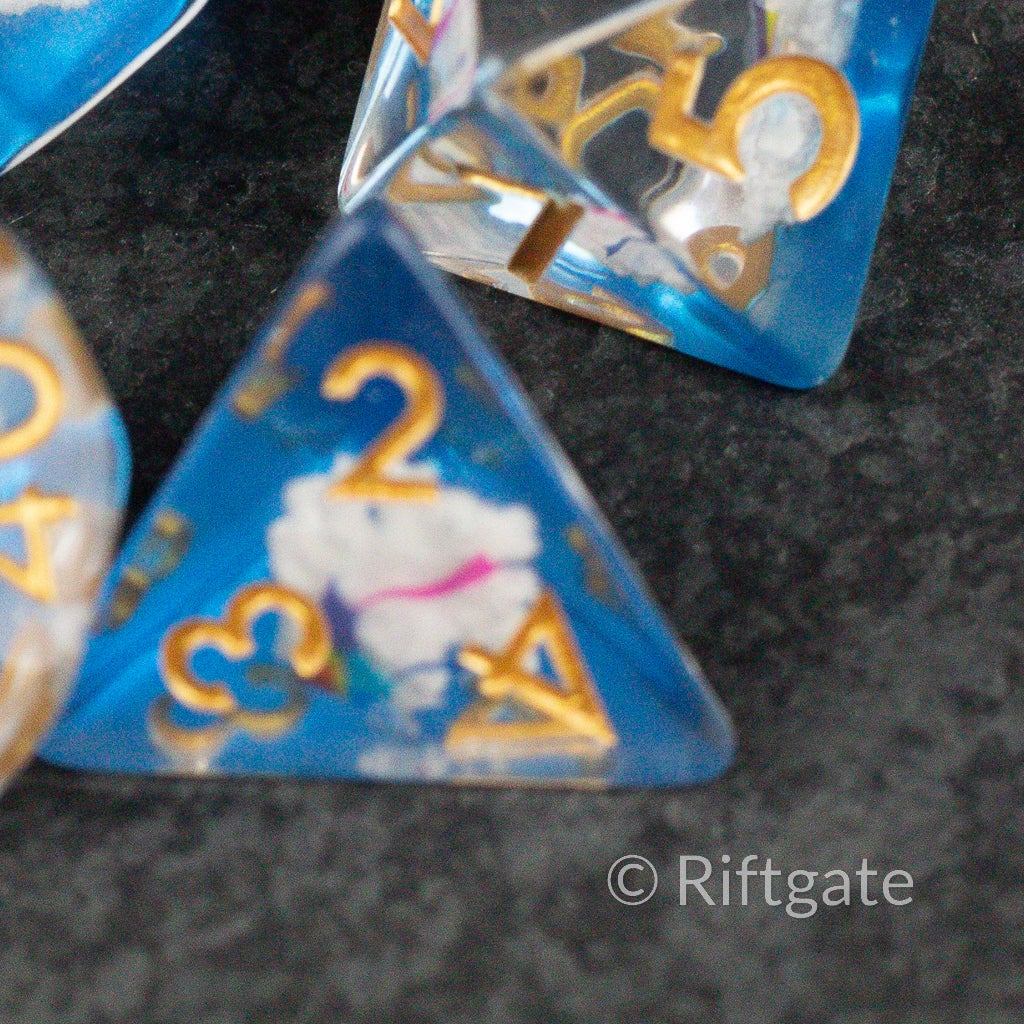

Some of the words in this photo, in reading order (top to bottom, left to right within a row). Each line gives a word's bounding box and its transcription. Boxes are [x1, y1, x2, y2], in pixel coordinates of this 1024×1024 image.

[647, 54, 860, 224] 5
[319, 341, 445, 501] 2
[160, 581, 334, 714] 3
[458, 586, 618, 750] 4
